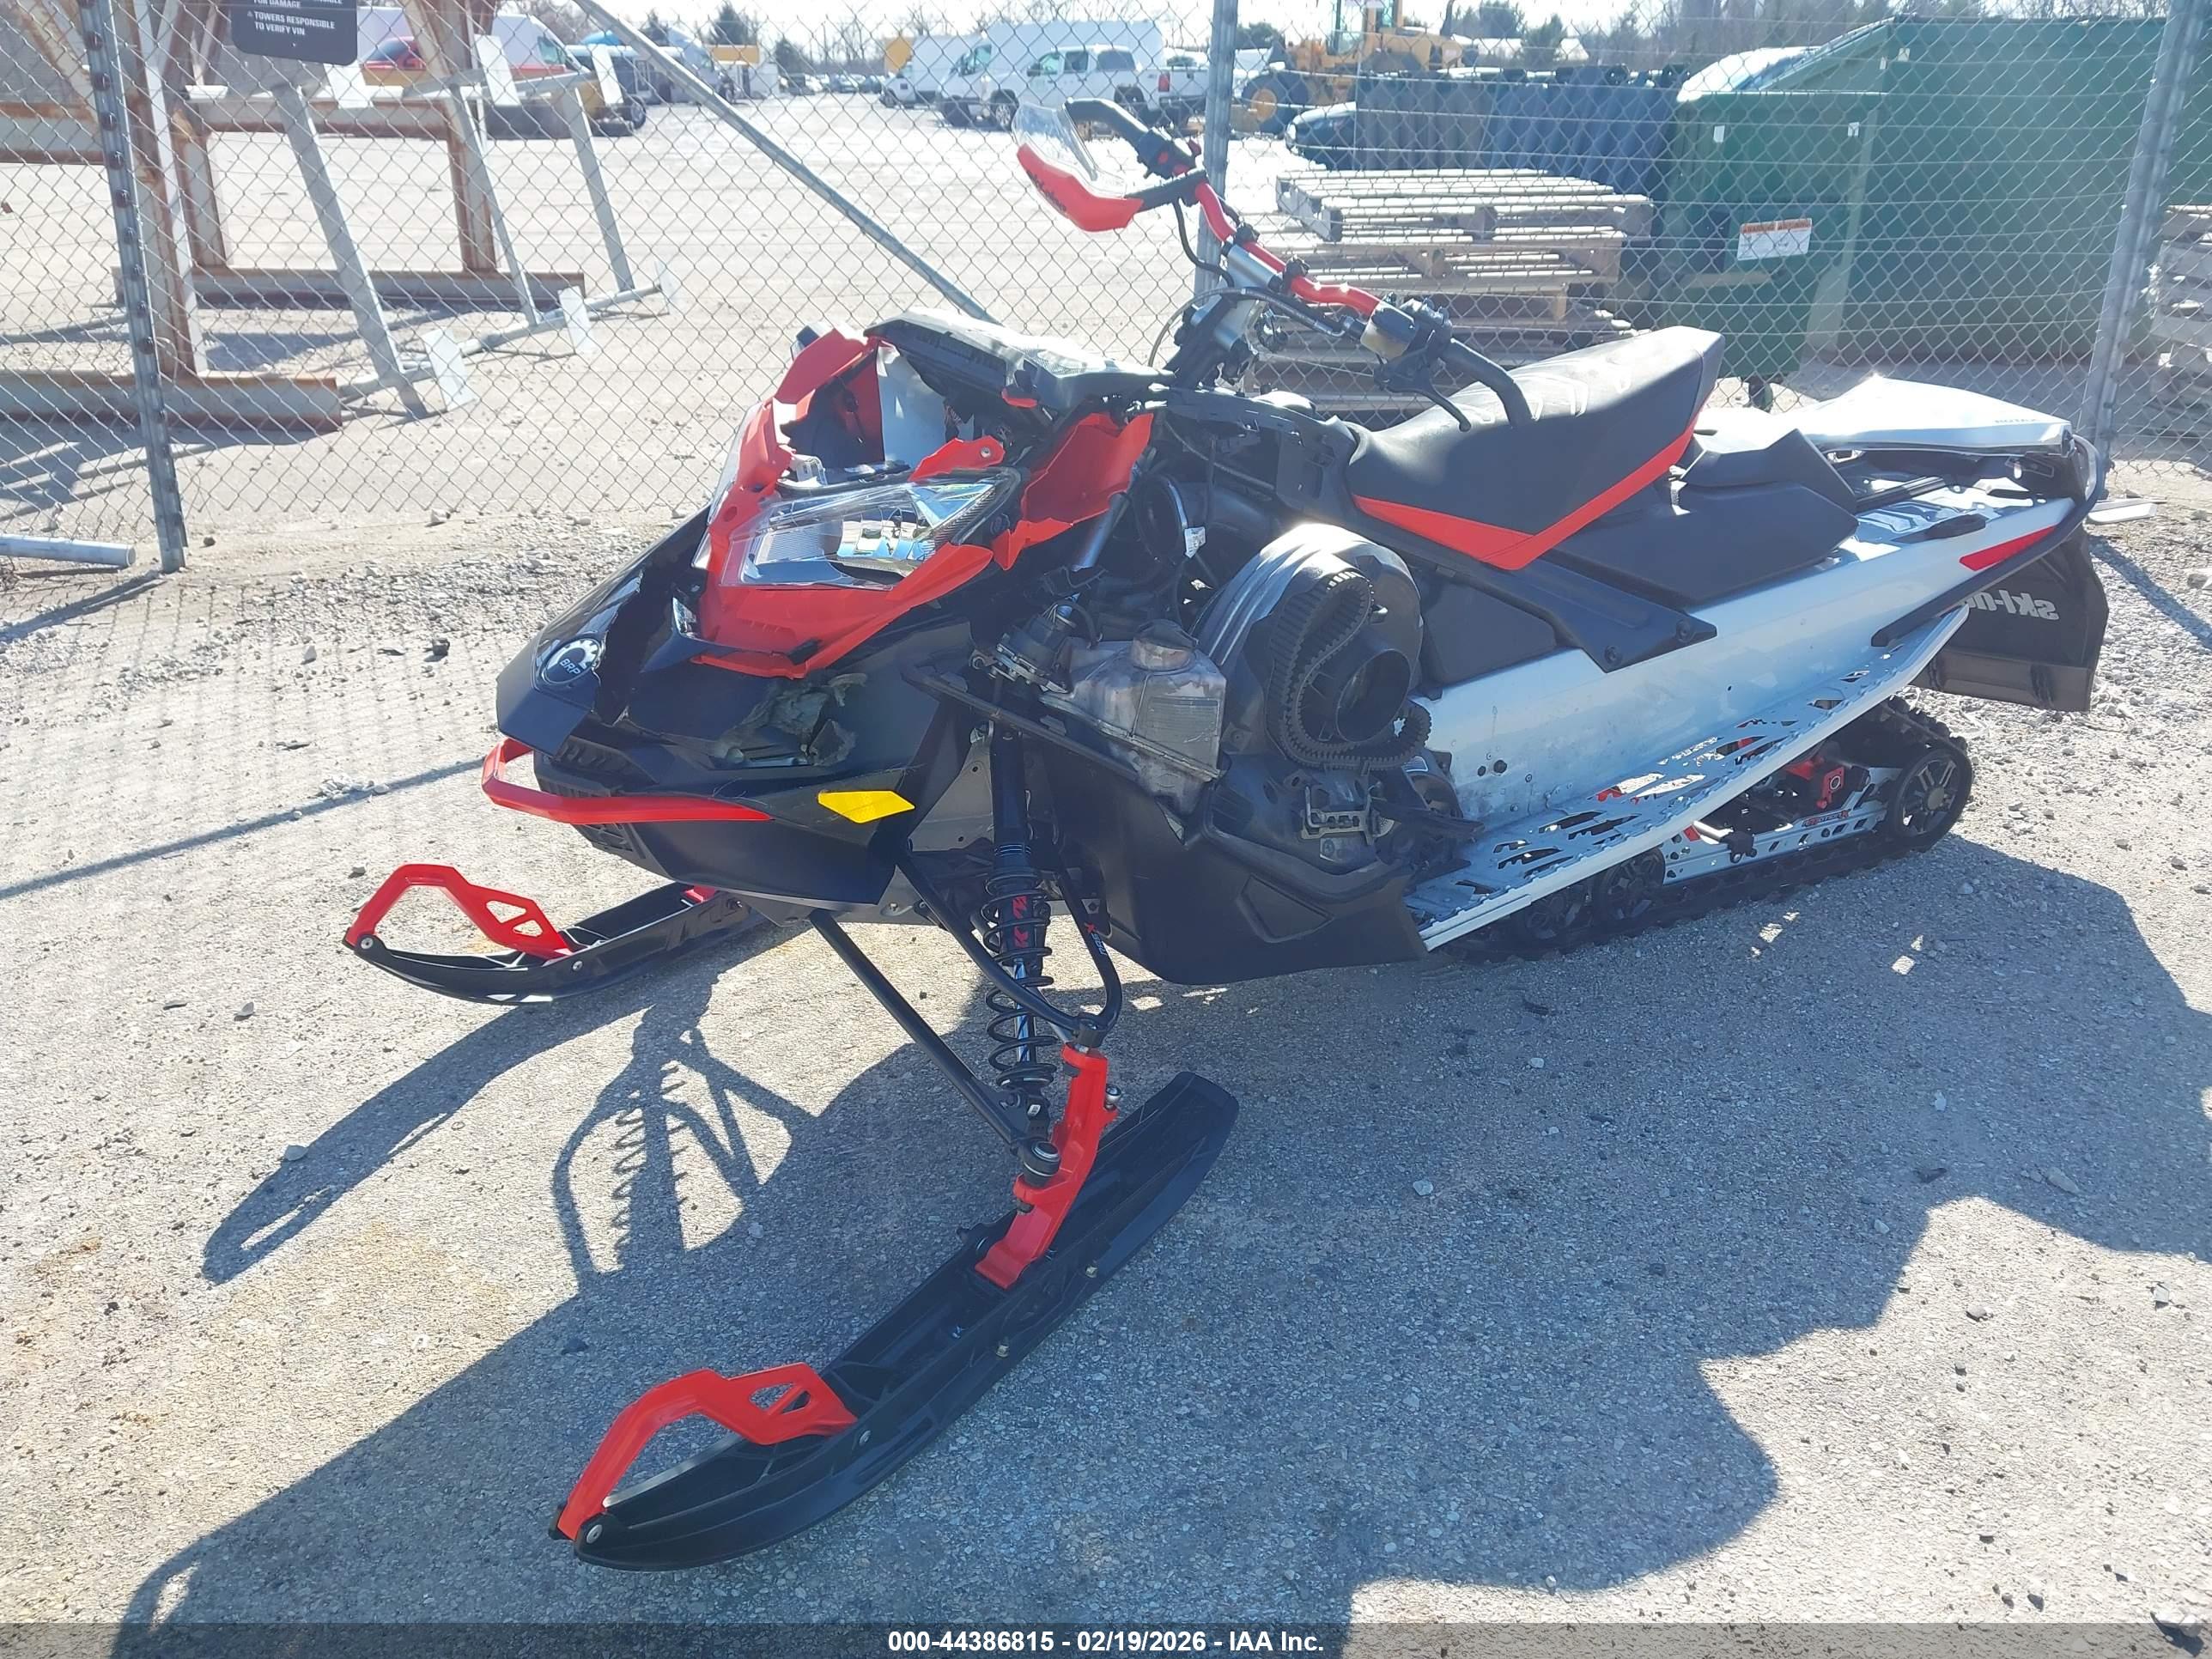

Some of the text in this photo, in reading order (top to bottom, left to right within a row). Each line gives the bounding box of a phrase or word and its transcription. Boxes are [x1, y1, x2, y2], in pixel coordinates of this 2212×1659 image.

[254, 10, 336, 29] TOWERS RESPONSIBLE
[254, 21, 306, 35] TO VERIFY VIN
[560, 658, 581, 675] BRP
